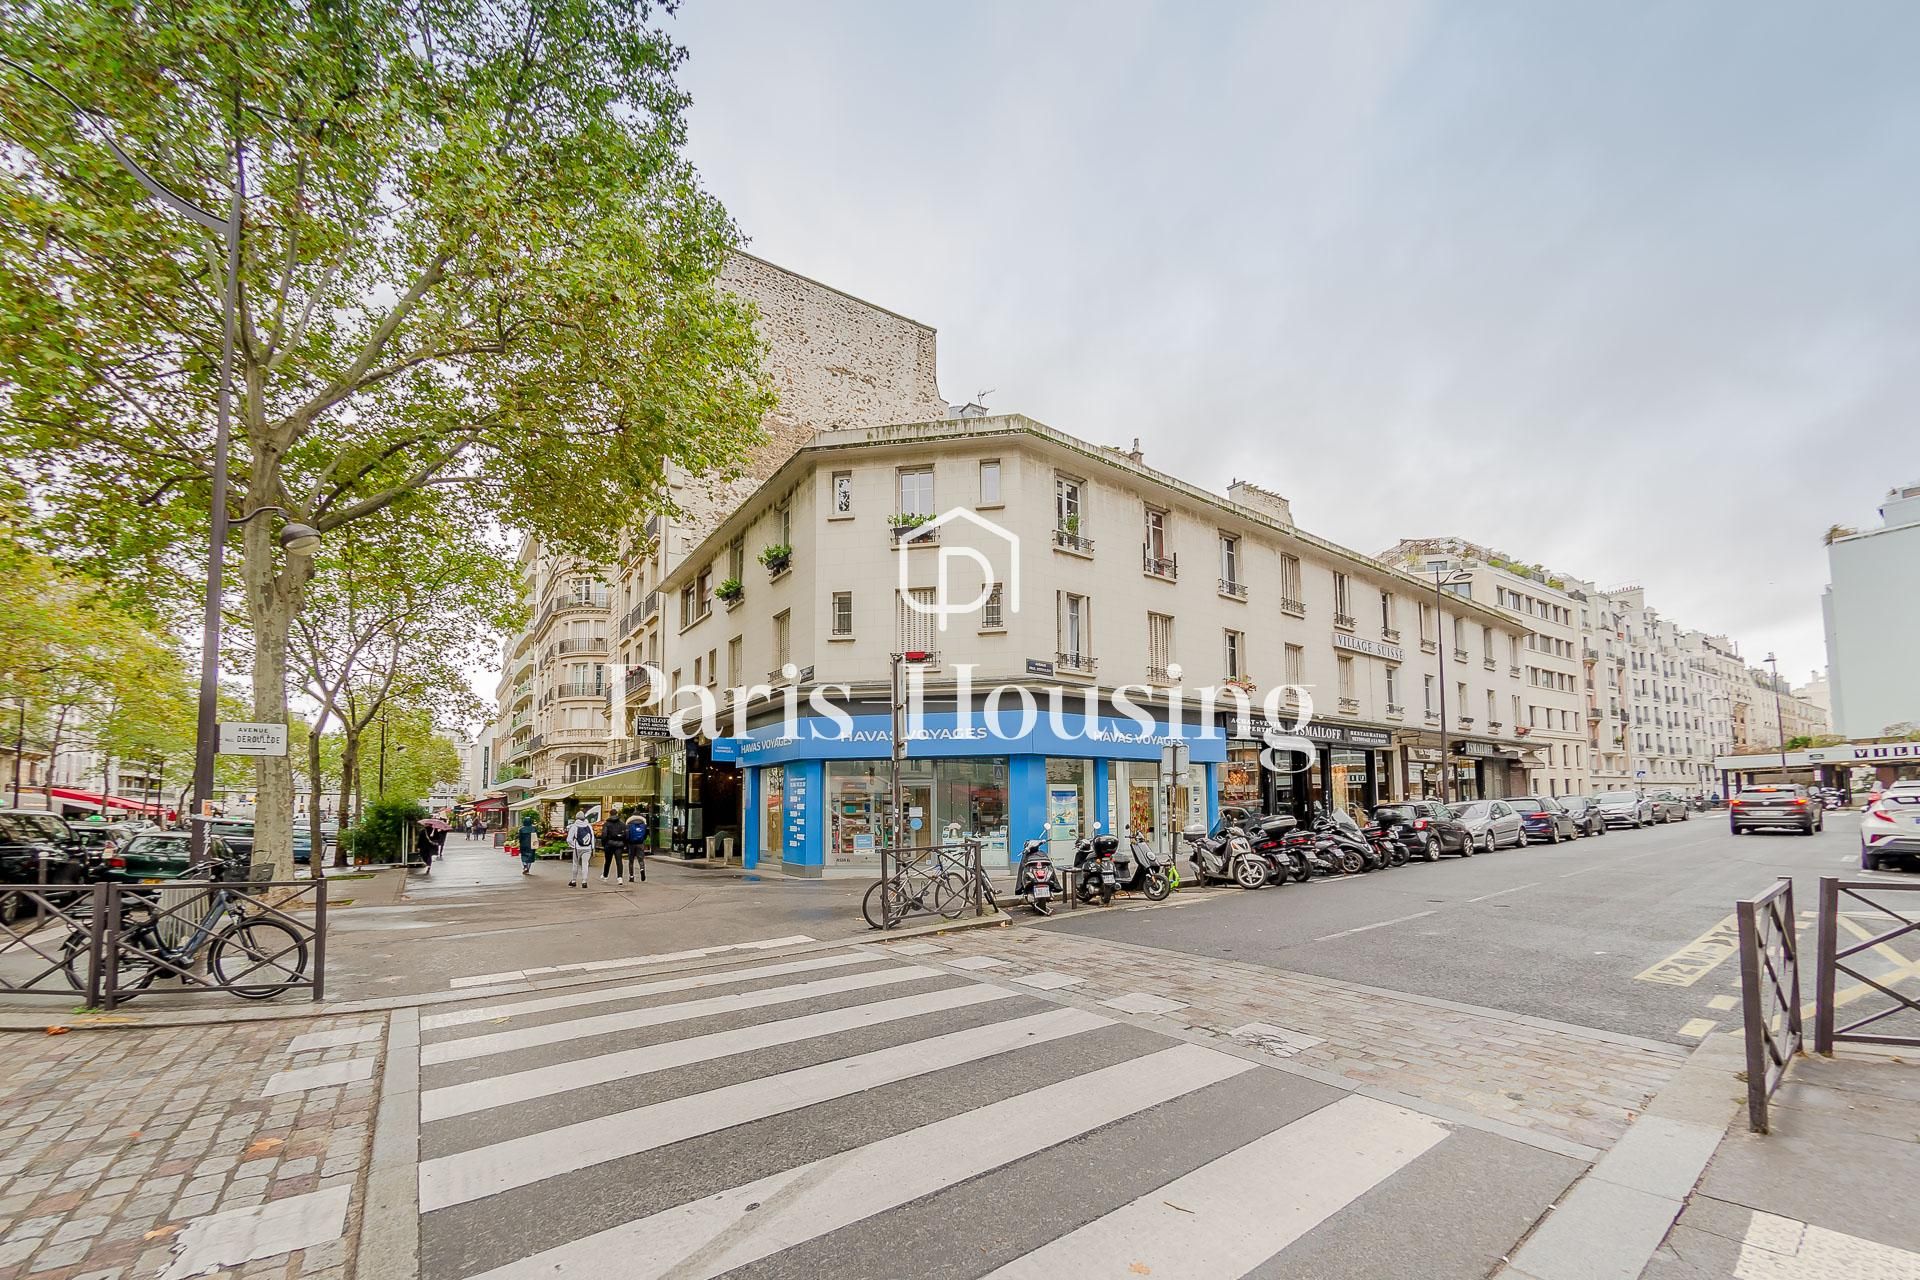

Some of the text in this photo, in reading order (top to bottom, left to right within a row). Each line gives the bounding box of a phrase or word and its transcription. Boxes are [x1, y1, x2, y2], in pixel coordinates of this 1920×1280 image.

[1337, 634, 1403, 660] VILLAGE SUISSE
[907, 727, 988, 740] VOYAGES
[1093, 731, 1184, 747] HAVAS VOYAGES
[741, 742, 761, 754] HAVAS
[761, 737, 793, 750] VOYAGES
